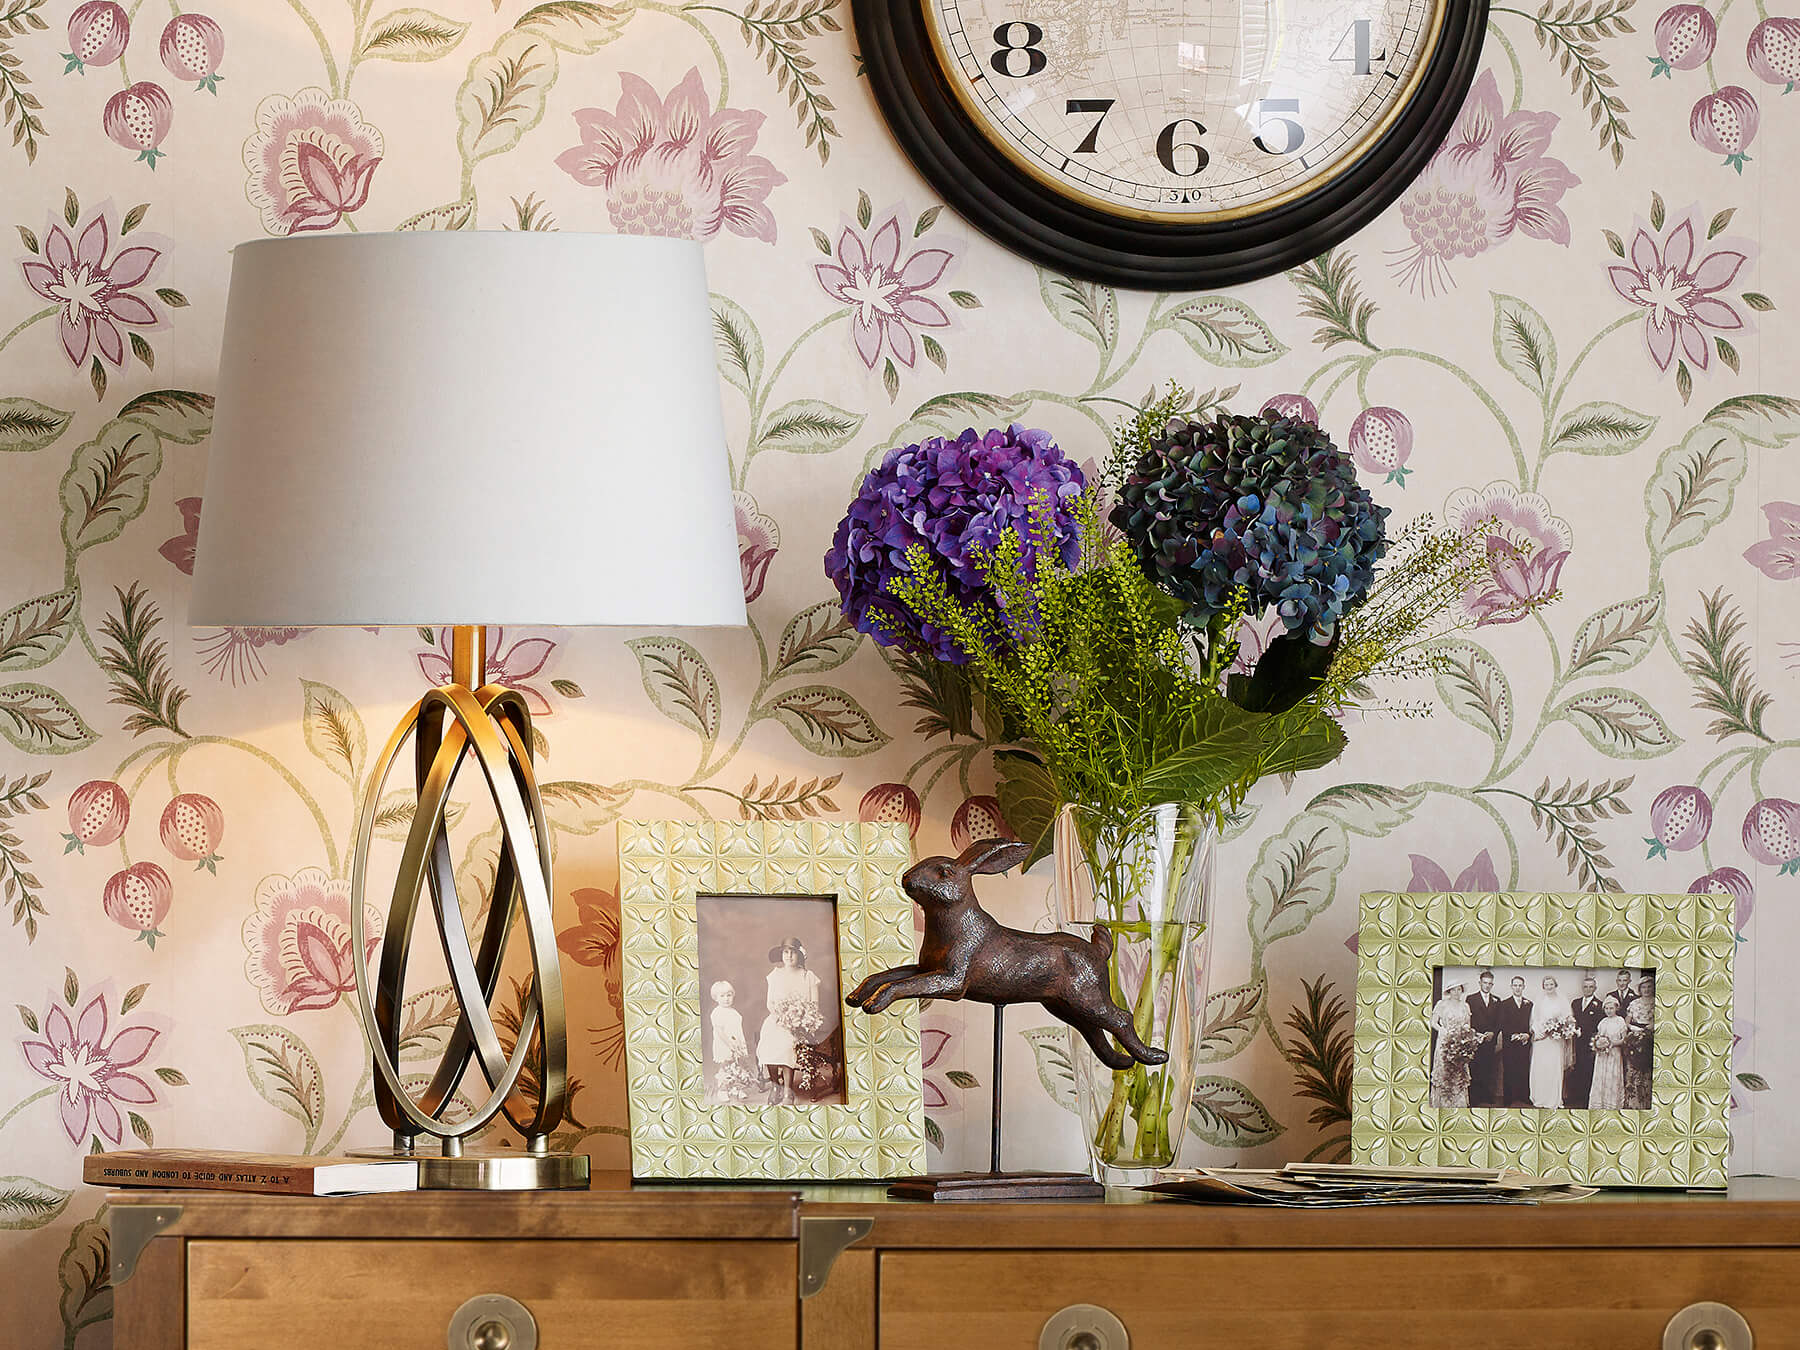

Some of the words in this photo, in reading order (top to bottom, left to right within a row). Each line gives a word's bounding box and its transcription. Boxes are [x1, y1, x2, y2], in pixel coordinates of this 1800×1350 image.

[990, 21, 1047, 78] 8
[1328, 19, 1385, 75] 4
[1066, 99, 1116, 153] 7
[1252, 99, 1305, 155] 5
[1156, 119, 1209, 176] 6
[103, 1168, 132, 1176] SUBURBS
[135, 1169, 148, 1178] AND
[152, 1170, 179, 1179] LONDON
[182, 1172, 191, 1180] TO
[194, 1172, 215, 1181] GUIDE
[219, 1173, 232, 1182] AND
[236, 1174, 256, 1183] ATLAS
[260, 1175, 267, 1184] Z
[270, 1176, 279, 1184] TO
